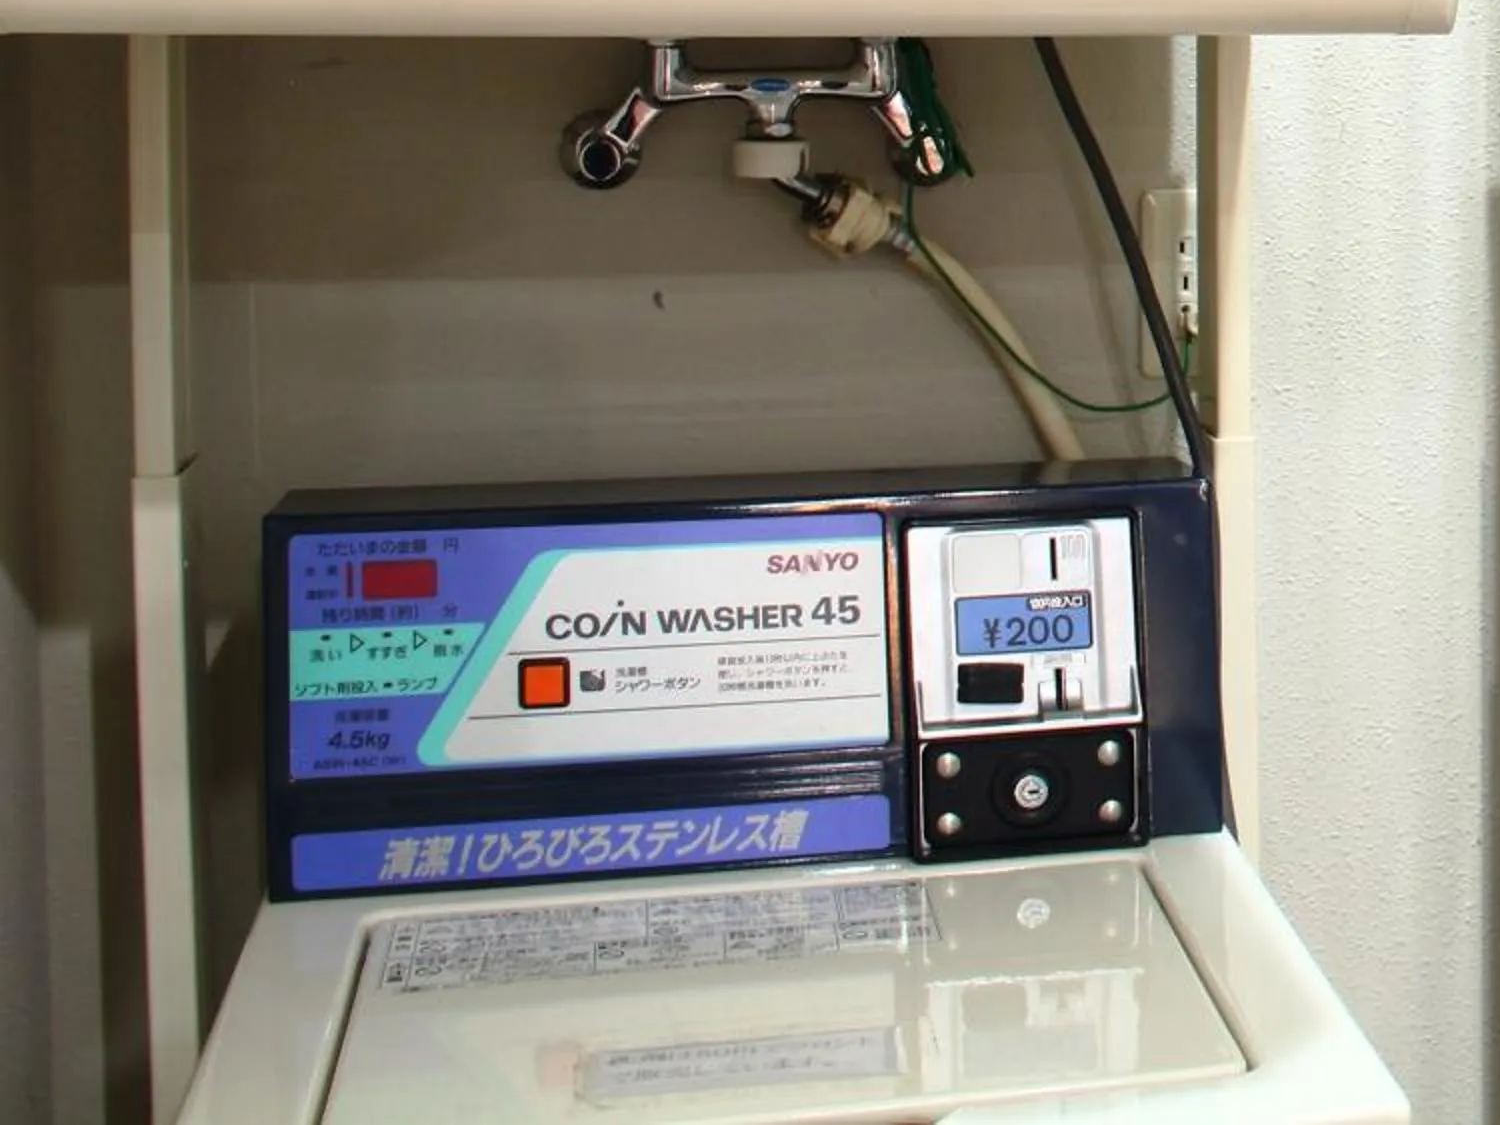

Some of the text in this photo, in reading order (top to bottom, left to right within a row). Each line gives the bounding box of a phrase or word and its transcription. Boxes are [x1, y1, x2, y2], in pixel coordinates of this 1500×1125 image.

[443, 537, 459, 554] 円
[767, 550, 859, 574] SANYO
[656, 603, 804, 634] WASHER
[811, 594, 862, 625] 45
[984, 614, 1075, 649] ¥200
[367, 646, 408, 660] すすぎ
[400, 676, 438, 692] ランプ
[615, 676, 701, 693] シャワーボタン
[327, 730, 391, 750] 4.5kg
[380, 811, 807, 879] 清潔!ひろびろステンレス槽
